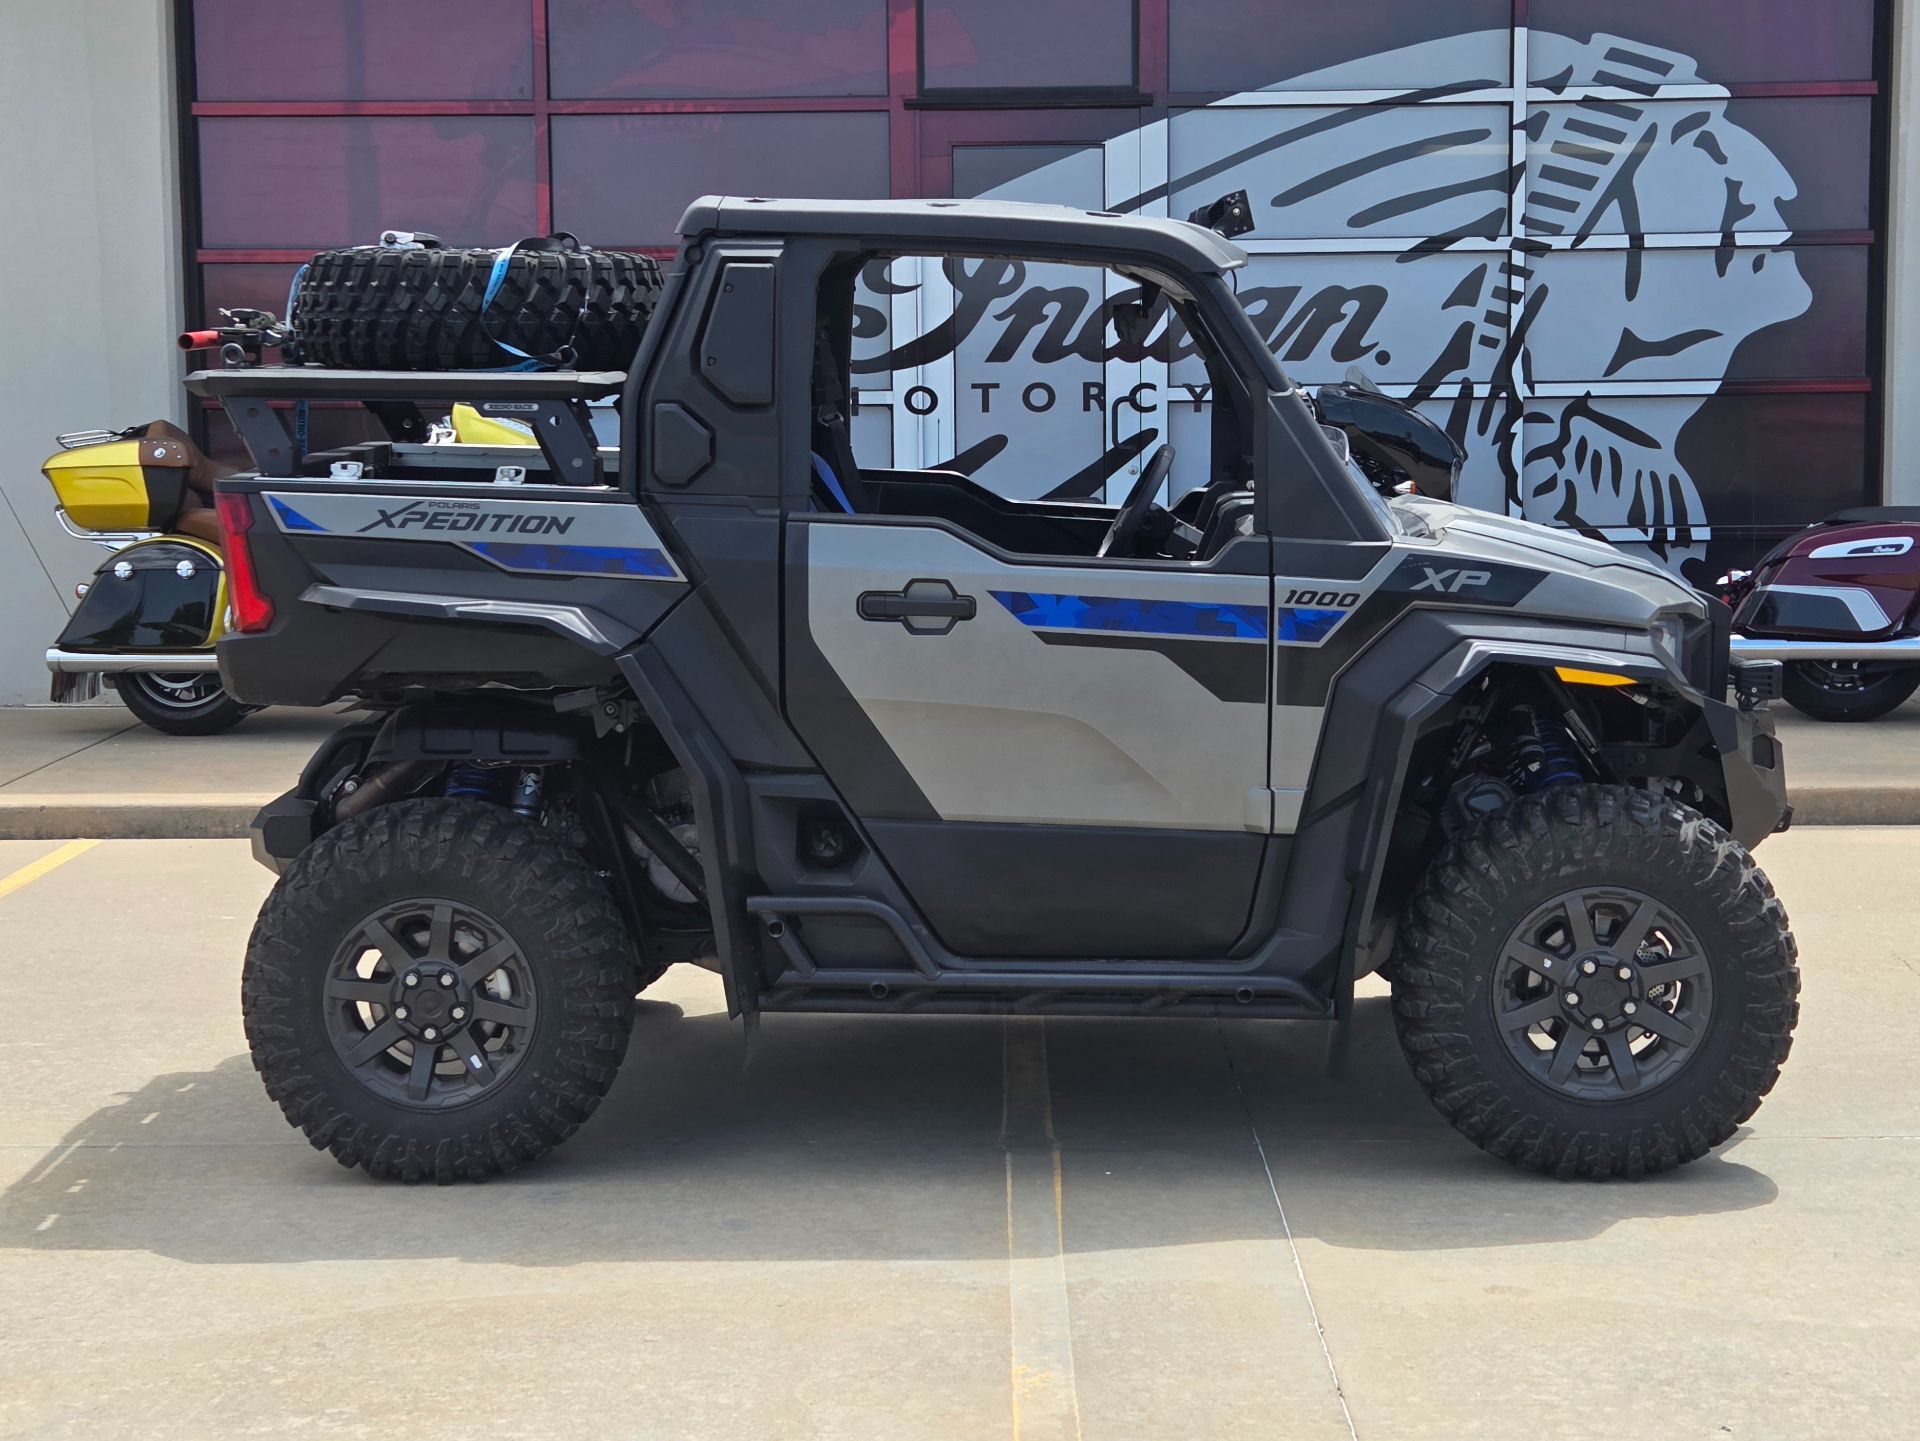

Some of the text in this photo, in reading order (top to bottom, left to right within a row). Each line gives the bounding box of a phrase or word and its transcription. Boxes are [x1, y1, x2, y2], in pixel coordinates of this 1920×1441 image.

[851, 382, 1211, 415] OTORCY
[356, 501, 576, 534] XPEDITION
[428, 501, 481, 510] POLARIS
[1409, 567, 1492, 592] XP
[1284, 589, 1361, 608] 1000
